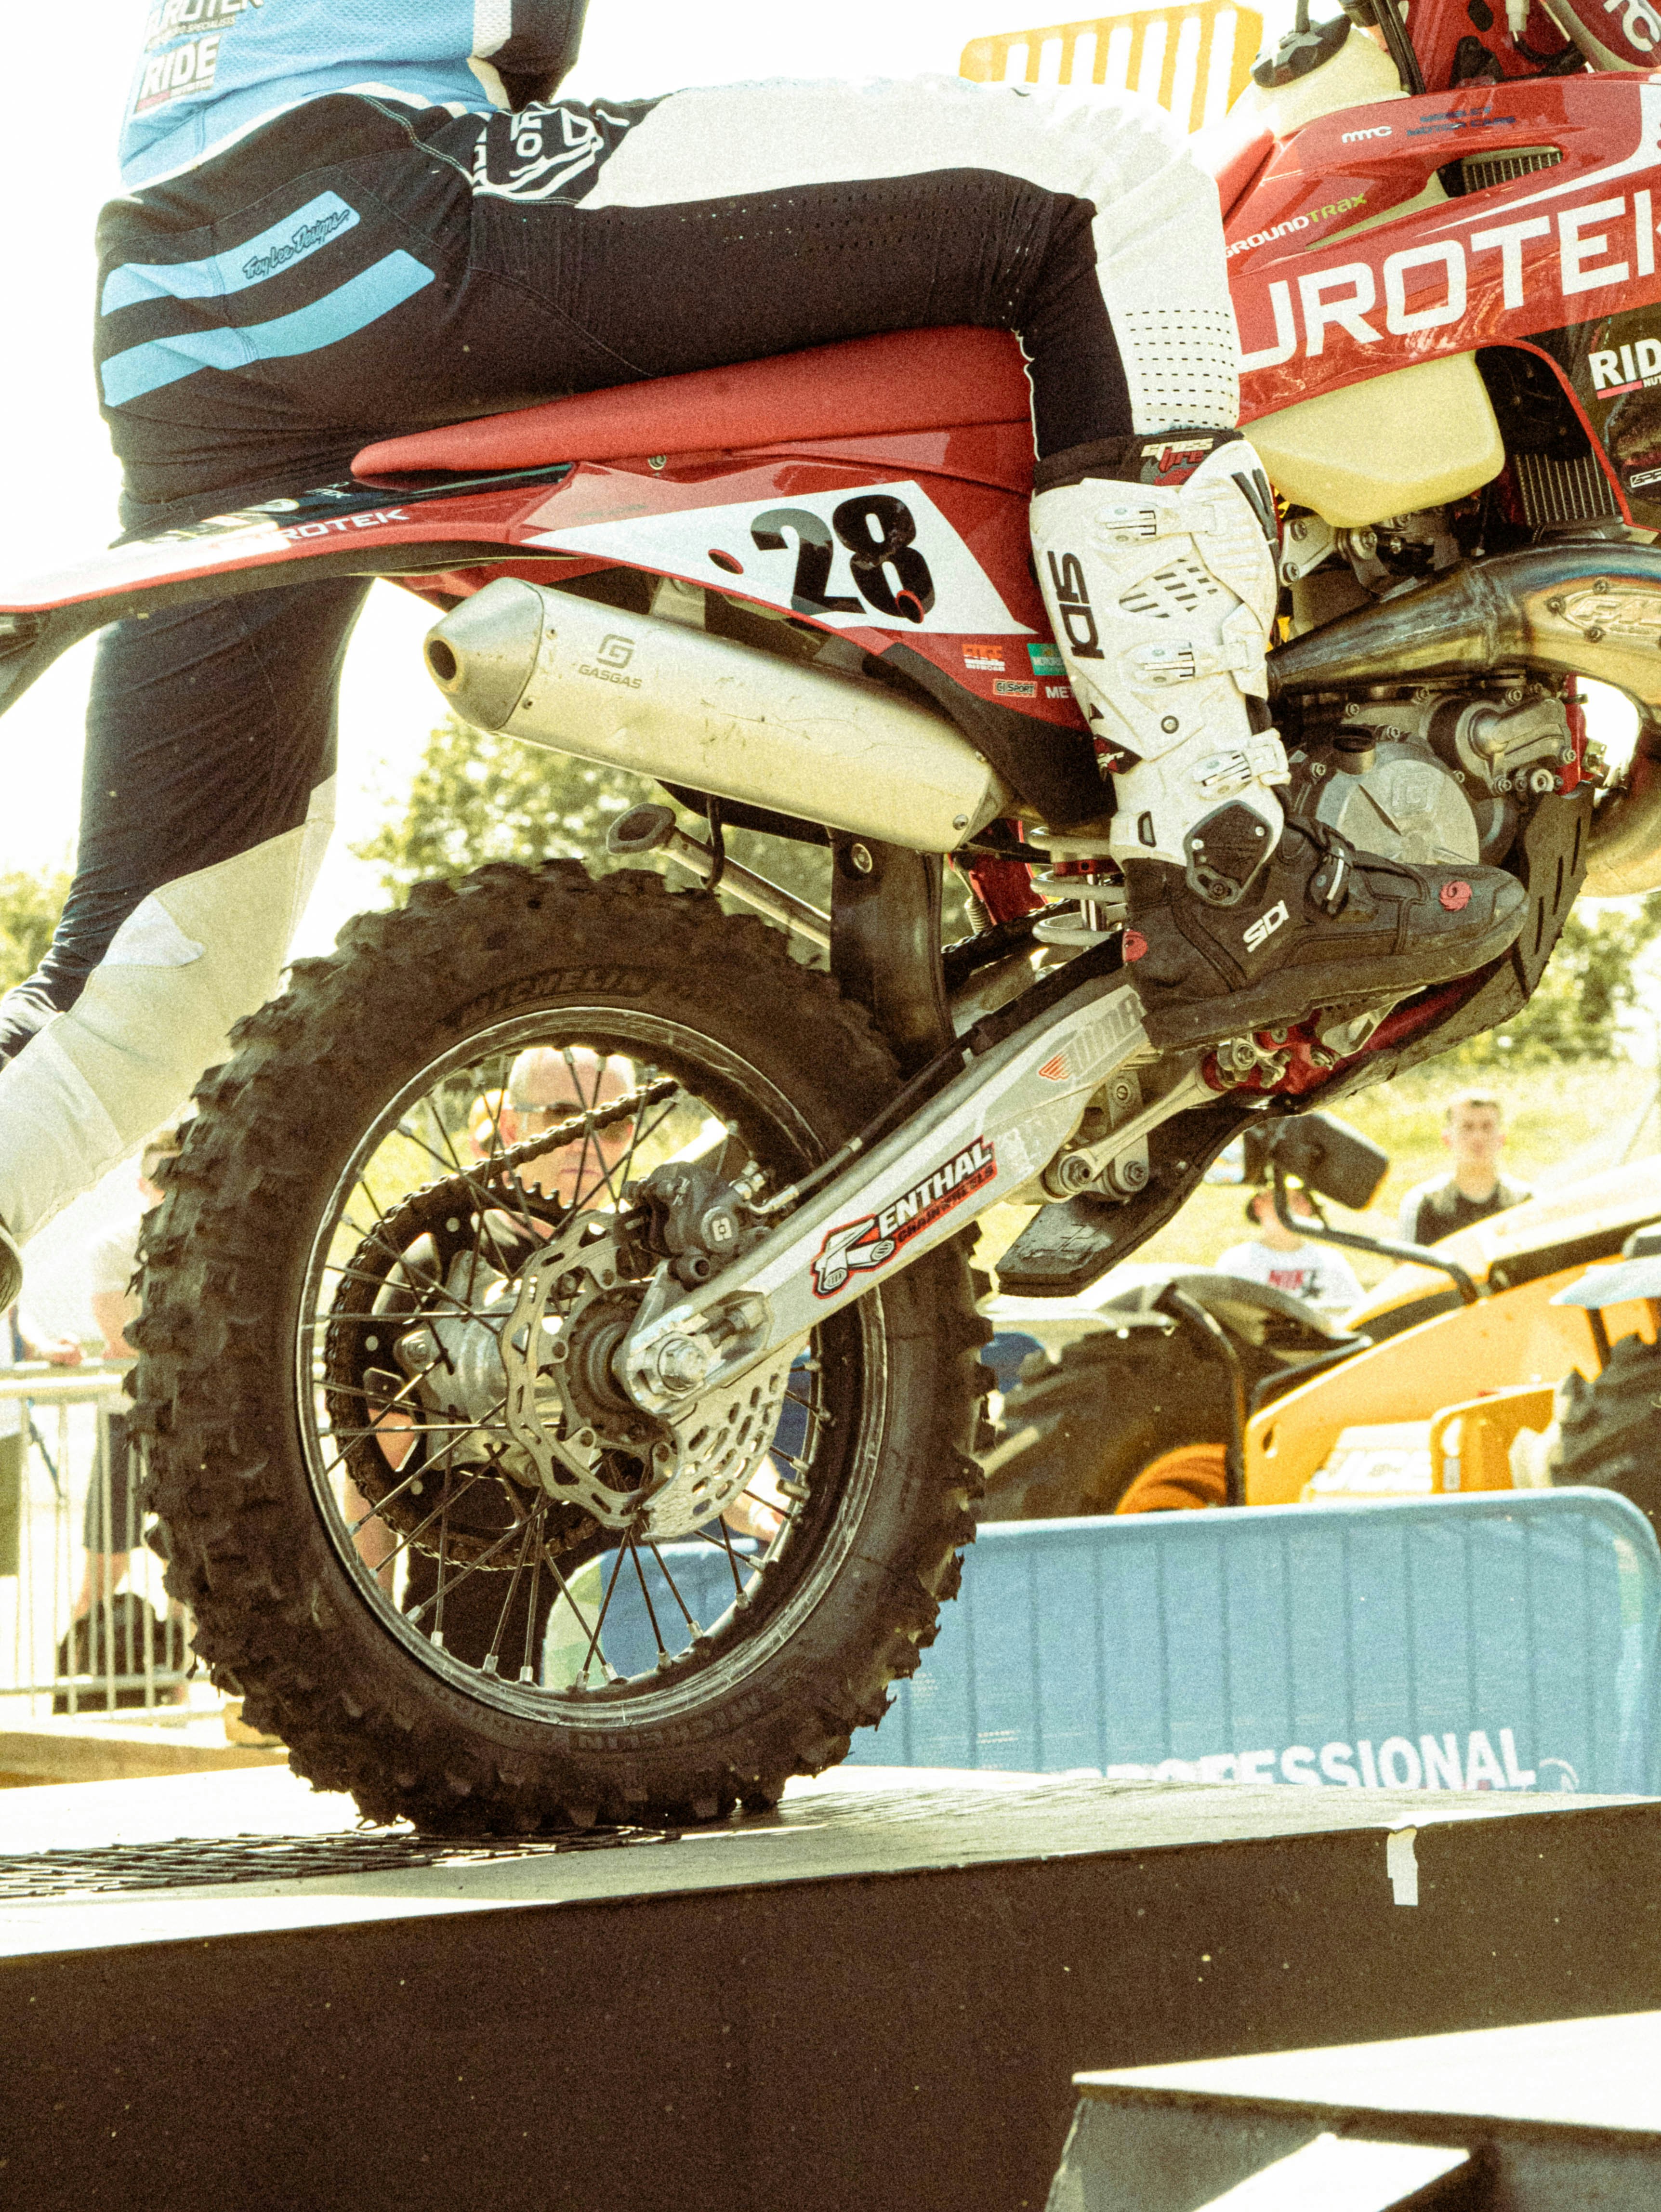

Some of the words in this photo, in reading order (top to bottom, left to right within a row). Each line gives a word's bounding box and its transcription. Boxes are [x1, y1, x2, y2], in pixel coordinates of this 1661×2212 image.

[140, 33, 223, 100] RIDE
[242, 256, 269, 279] Troy
[270, 247, 294, 268] Lee
[292, 210, 350, 254] Designs
[750, 494, 936, 618] 28
[578, 664, 642, 689] GASGAS
